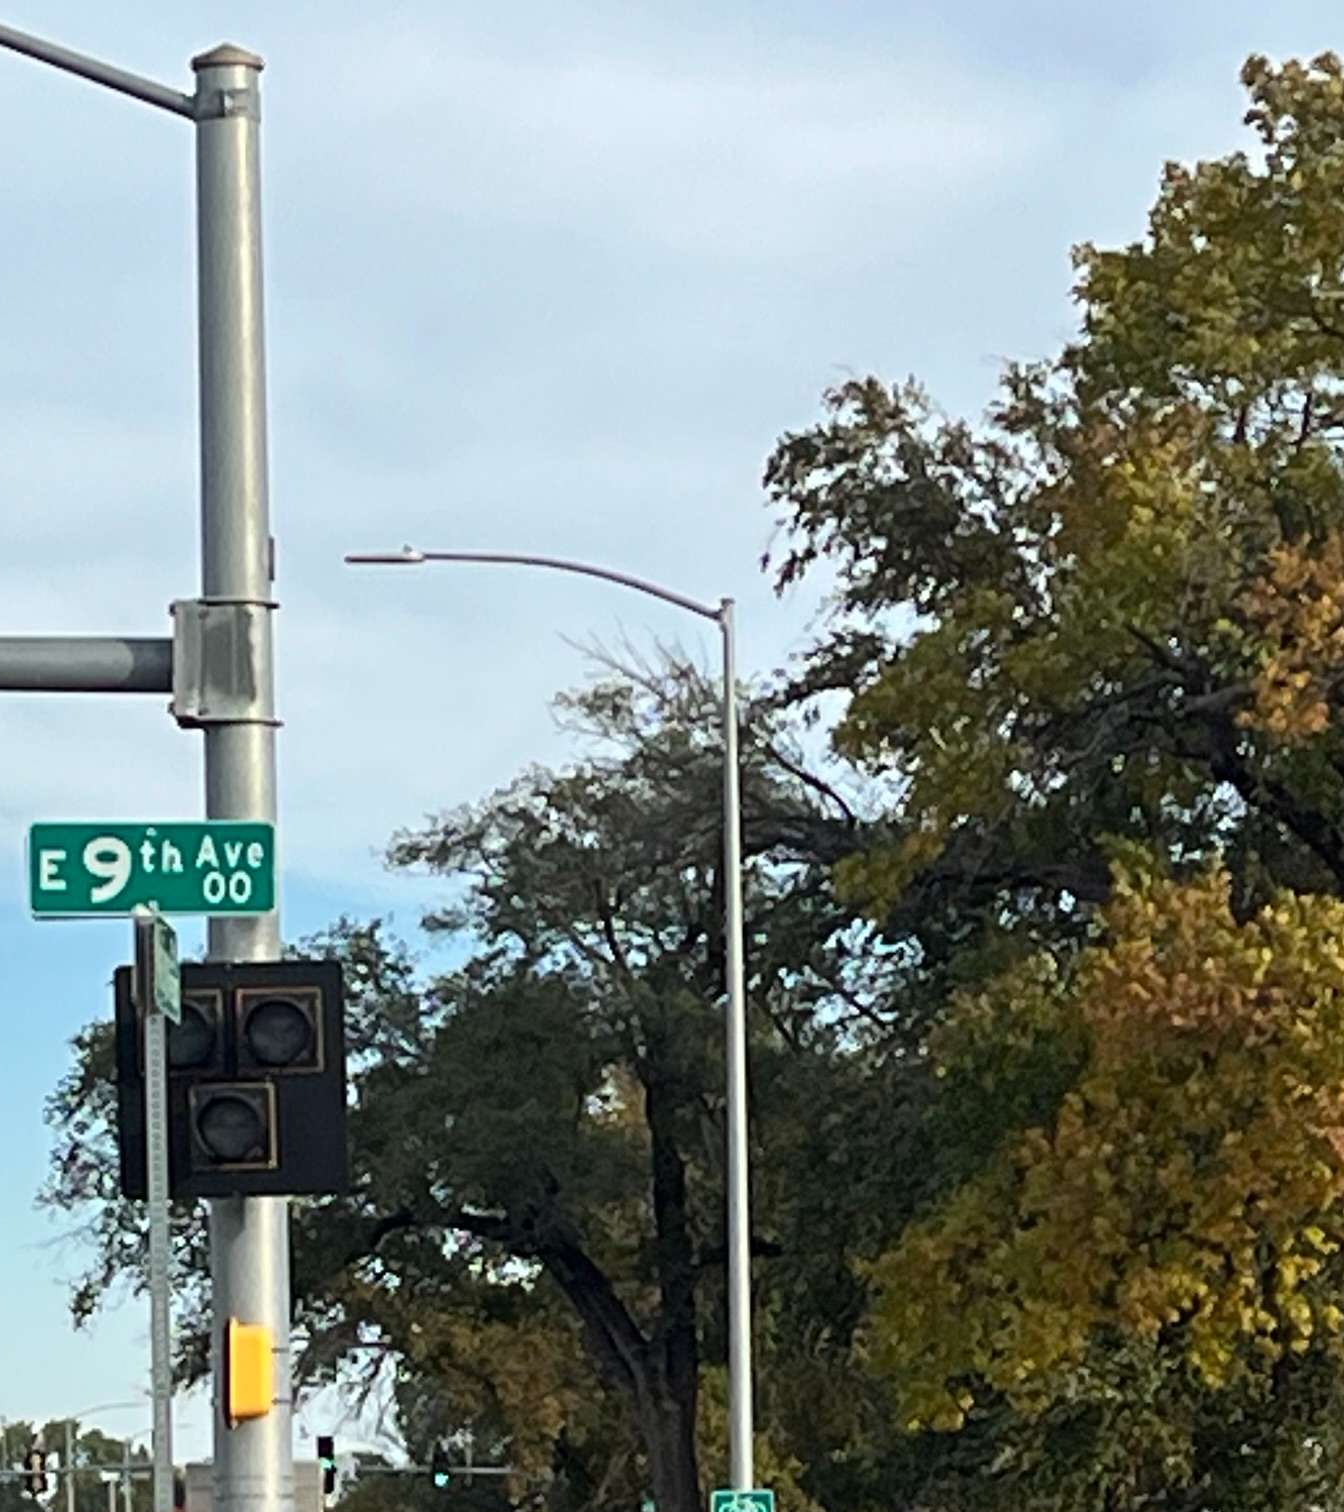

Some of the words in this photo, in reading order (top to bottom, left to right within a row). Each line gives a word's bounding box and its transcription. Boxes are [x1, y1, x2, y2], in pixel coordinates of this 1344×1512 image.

[39, 850, 67, 890] E
[82, 835, 183, 903] 9th
[195, 834, 264, 869] Ave
[203, 871, 252, 904] 00
